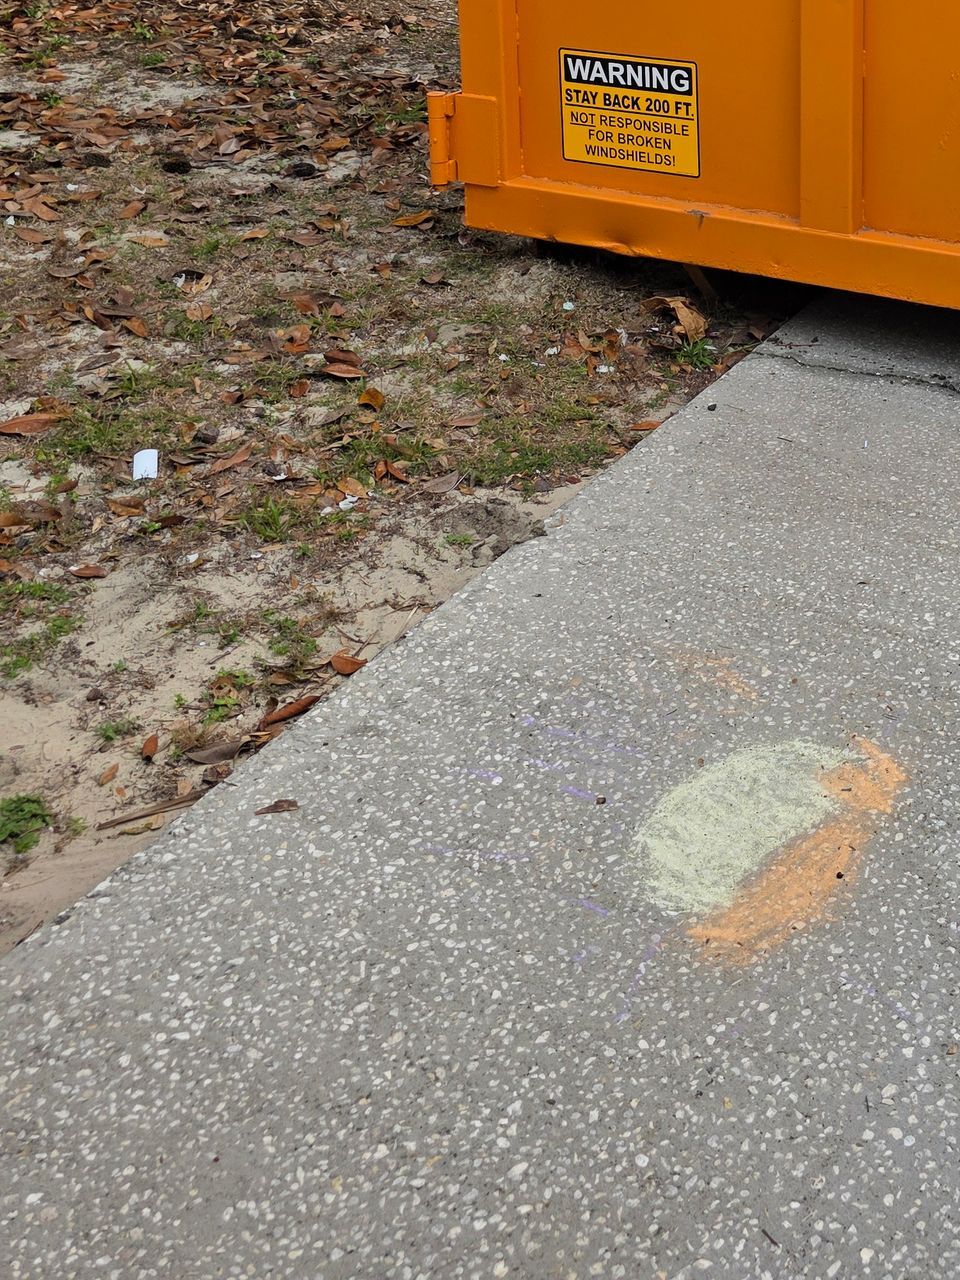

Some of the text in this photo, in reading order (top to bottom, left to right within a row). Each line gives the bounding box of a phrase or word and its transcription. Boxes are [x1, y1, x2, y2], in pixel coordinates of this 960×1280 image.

[567, 57, 690, 93] WARNING
[565, 88, 695, 117] STAY BACK 200 FT.
[570, 111, 689, 137] NOT RESPONSIBLE
[588, 129, 672, 151] FOR BROKEN
[585, 144, 676, 167] WINDSHIELDS!
